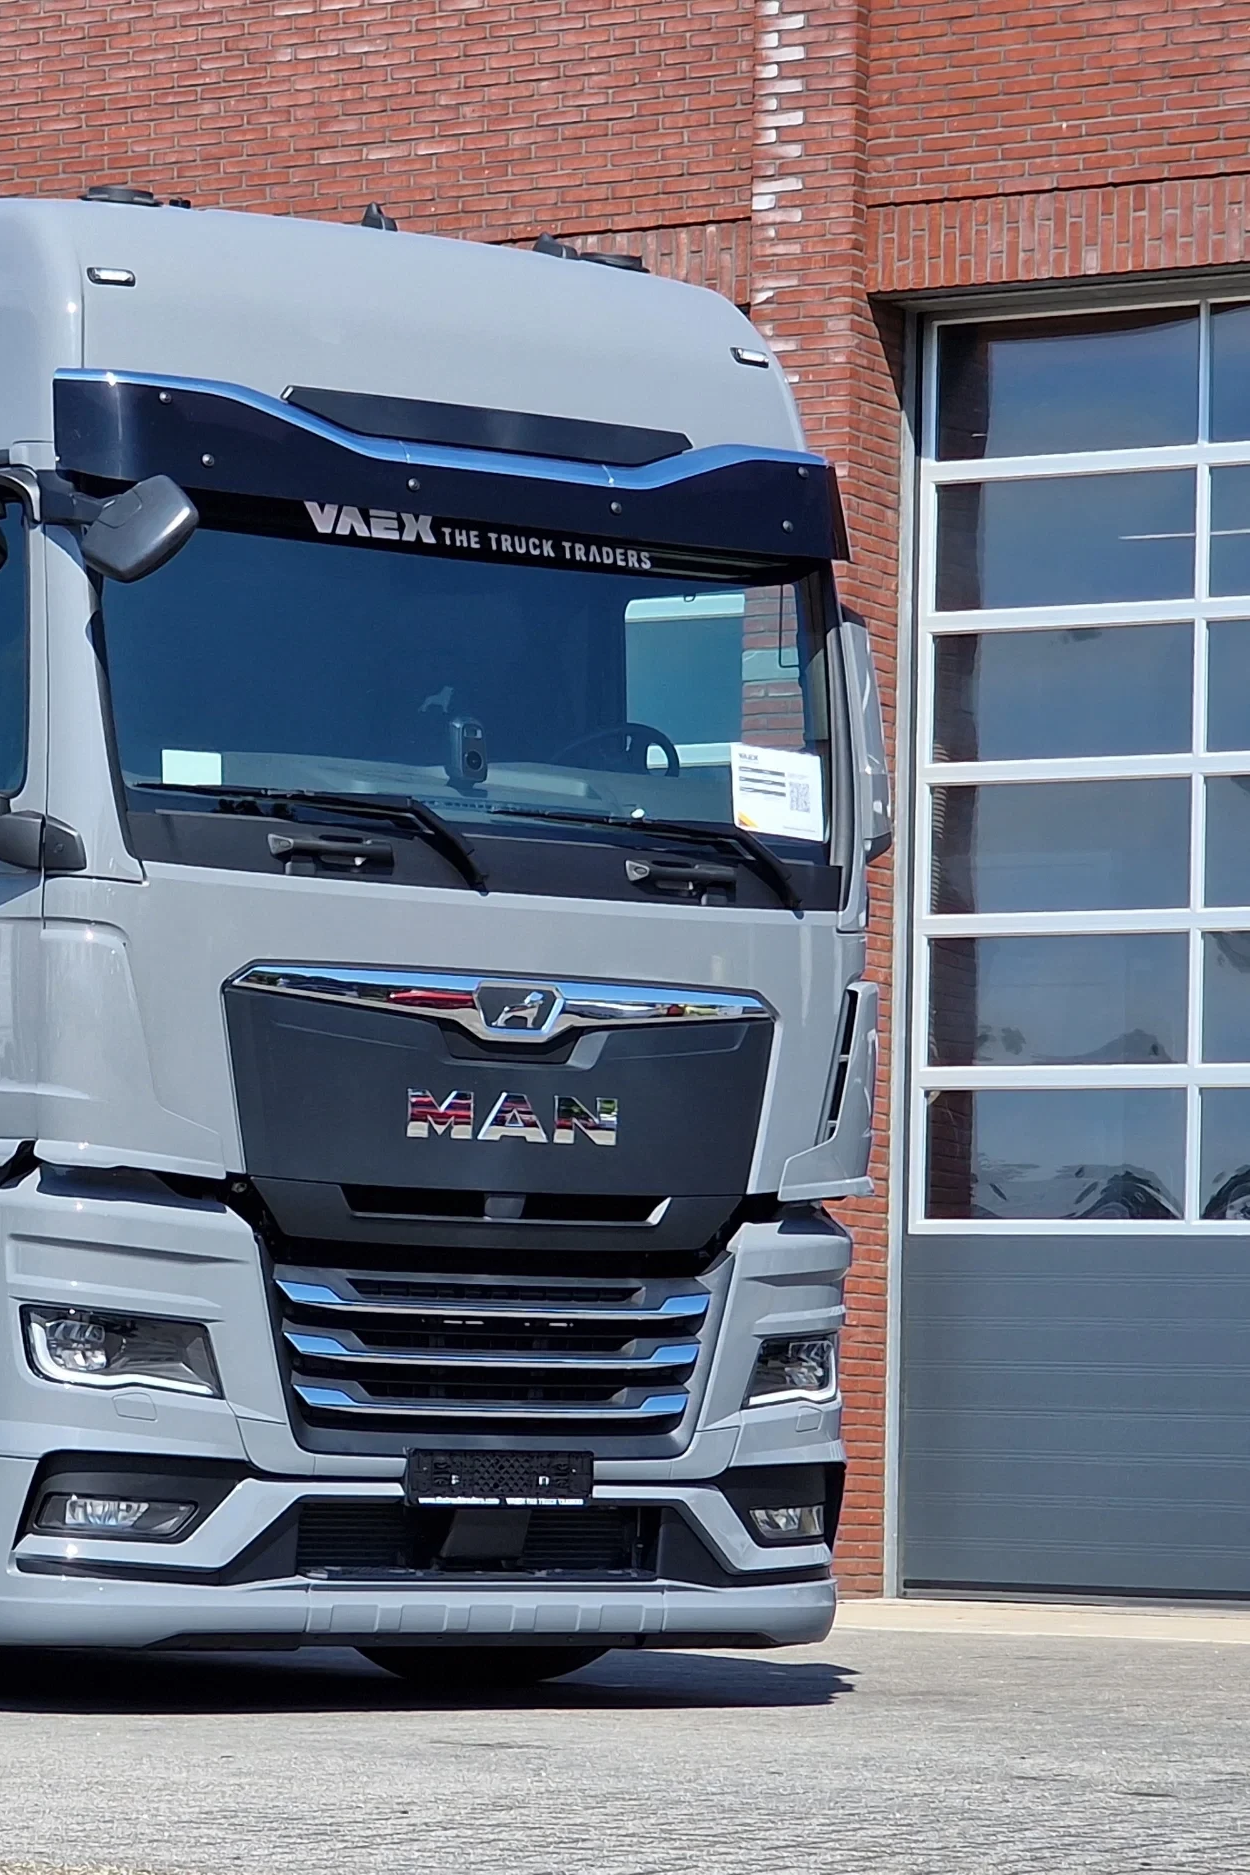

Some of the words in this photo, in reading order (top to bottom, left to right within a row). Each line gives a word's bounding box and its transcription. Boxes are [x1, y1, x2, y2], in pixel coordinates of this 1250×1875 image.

[303, 500, 437, 544] VAEX
[441, 526, 481, 549] THE
[488, 532, 556, 558] TRUCK
[561, 540, 652, 570] TRADERS
[406, 1088, 619, 1147] MAN
